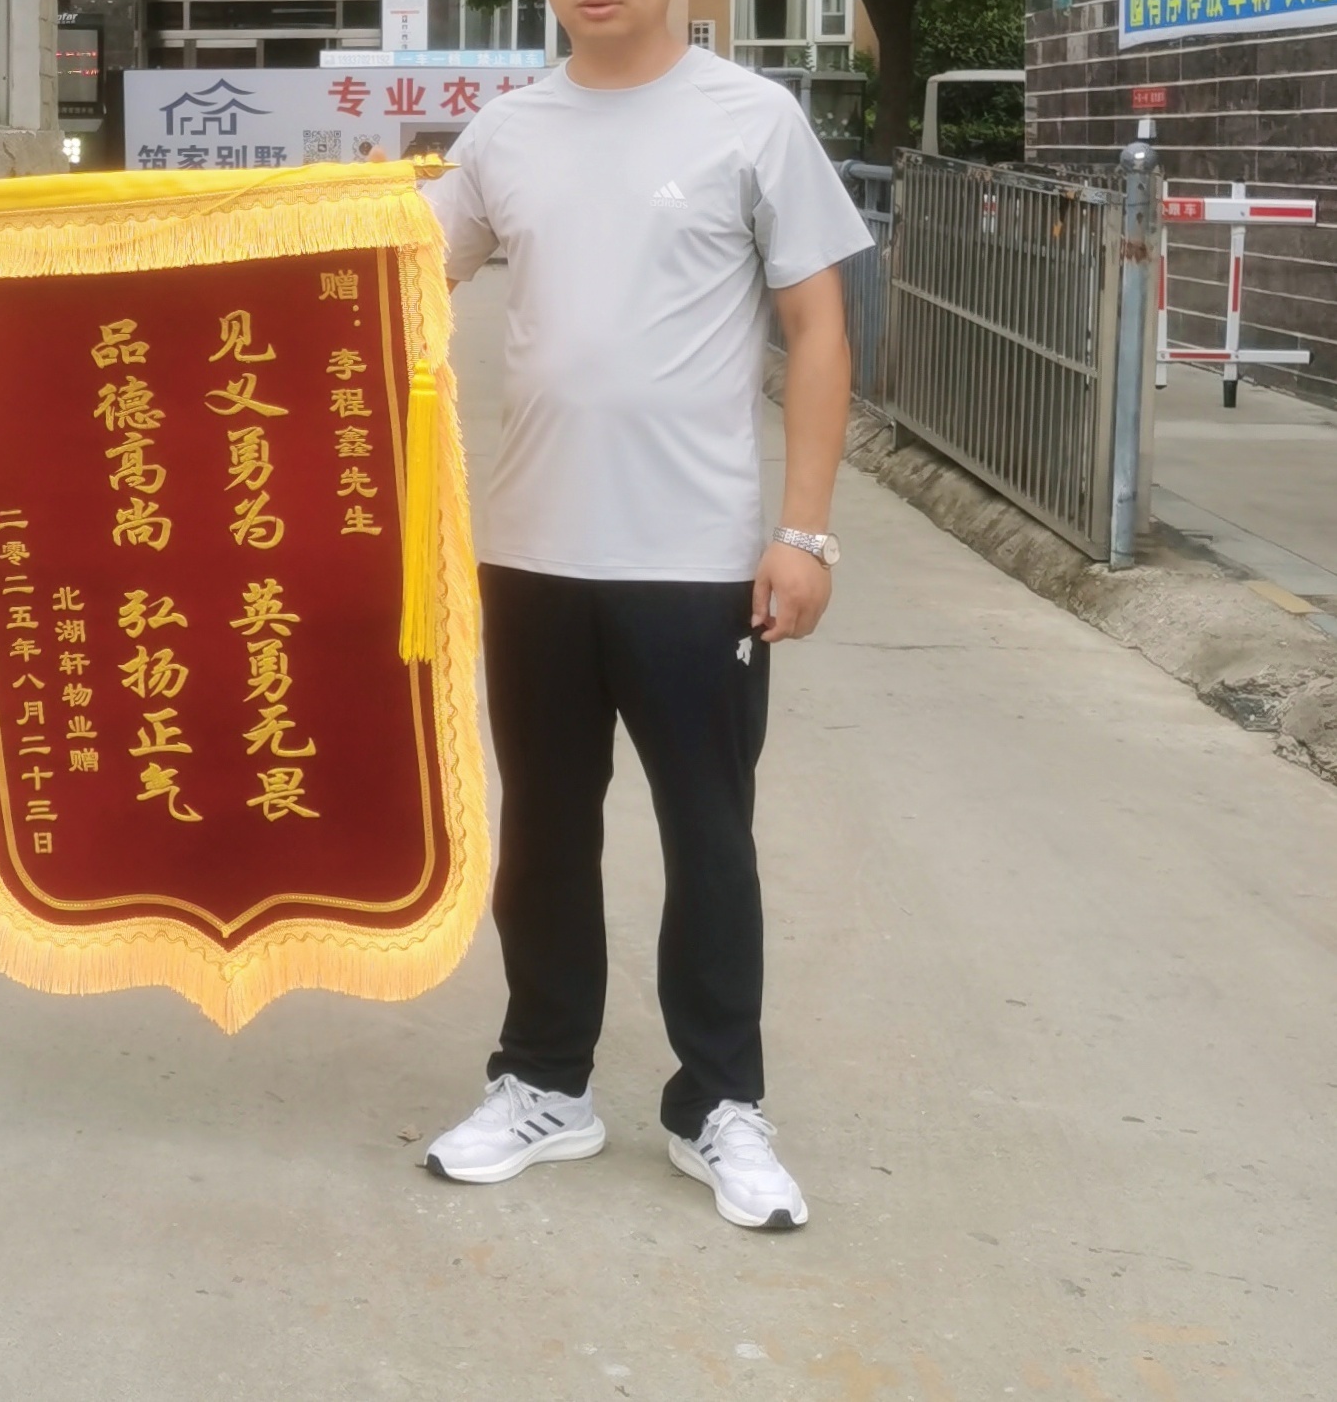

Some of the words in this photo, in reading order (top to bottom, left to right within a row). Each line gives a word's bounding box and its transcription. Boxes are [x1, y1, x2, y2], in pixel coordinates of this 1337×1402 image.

[649, 198, 689, 210] adidas
[91, 318, 173, 552] 品德高尚
[204, 309, 289, 549] 见义勇为
[52, 586, 99, 773] 北湖轩物业赠
[118, 589, 203, 822] 弘扬正气
[229, 578, 320, 821] 英勇无畏
